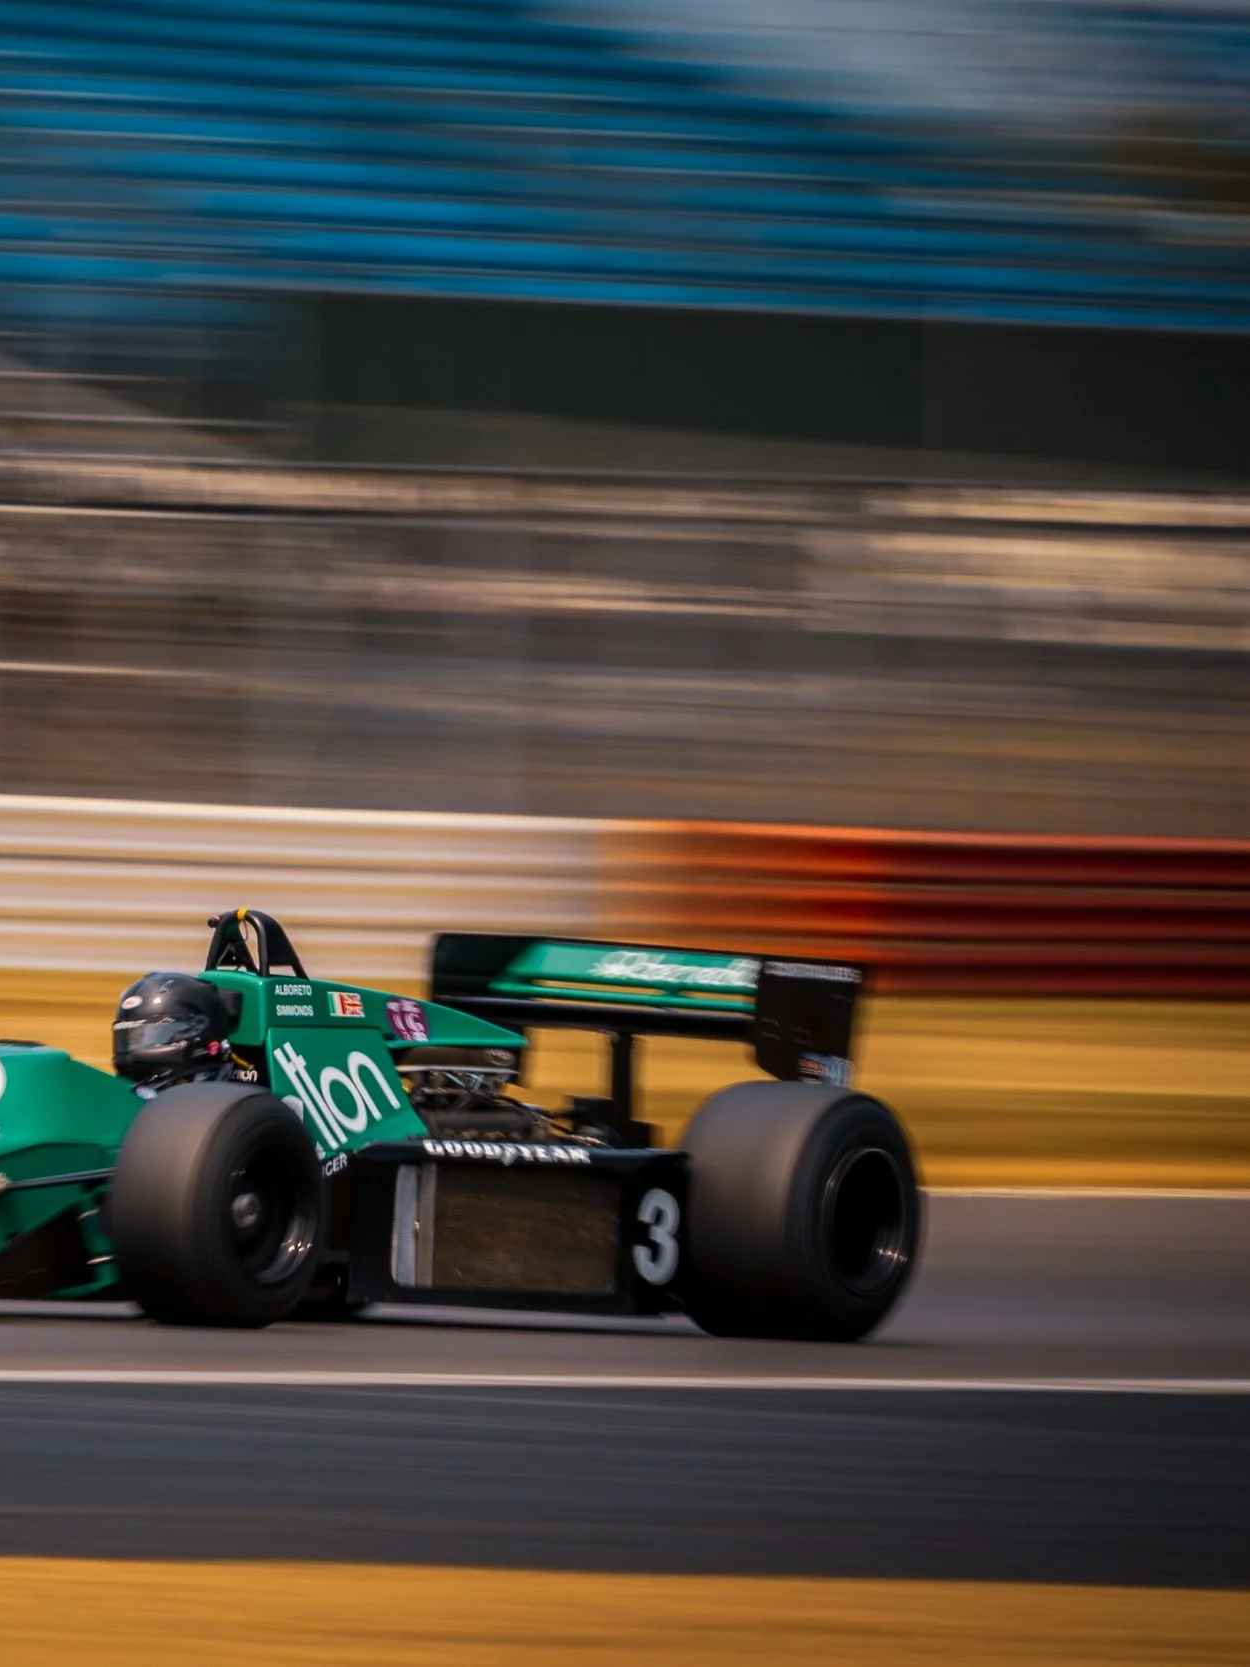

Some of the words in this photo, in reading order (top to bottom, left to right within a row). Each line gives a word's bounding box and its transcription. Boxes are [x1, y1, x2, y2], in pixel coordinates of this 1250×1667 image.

[274, 984, 313, 996] ALBORETO
[276, 1004, 314, 1017] SIMMONDS
[632, 1187, 680, 1286] 3
